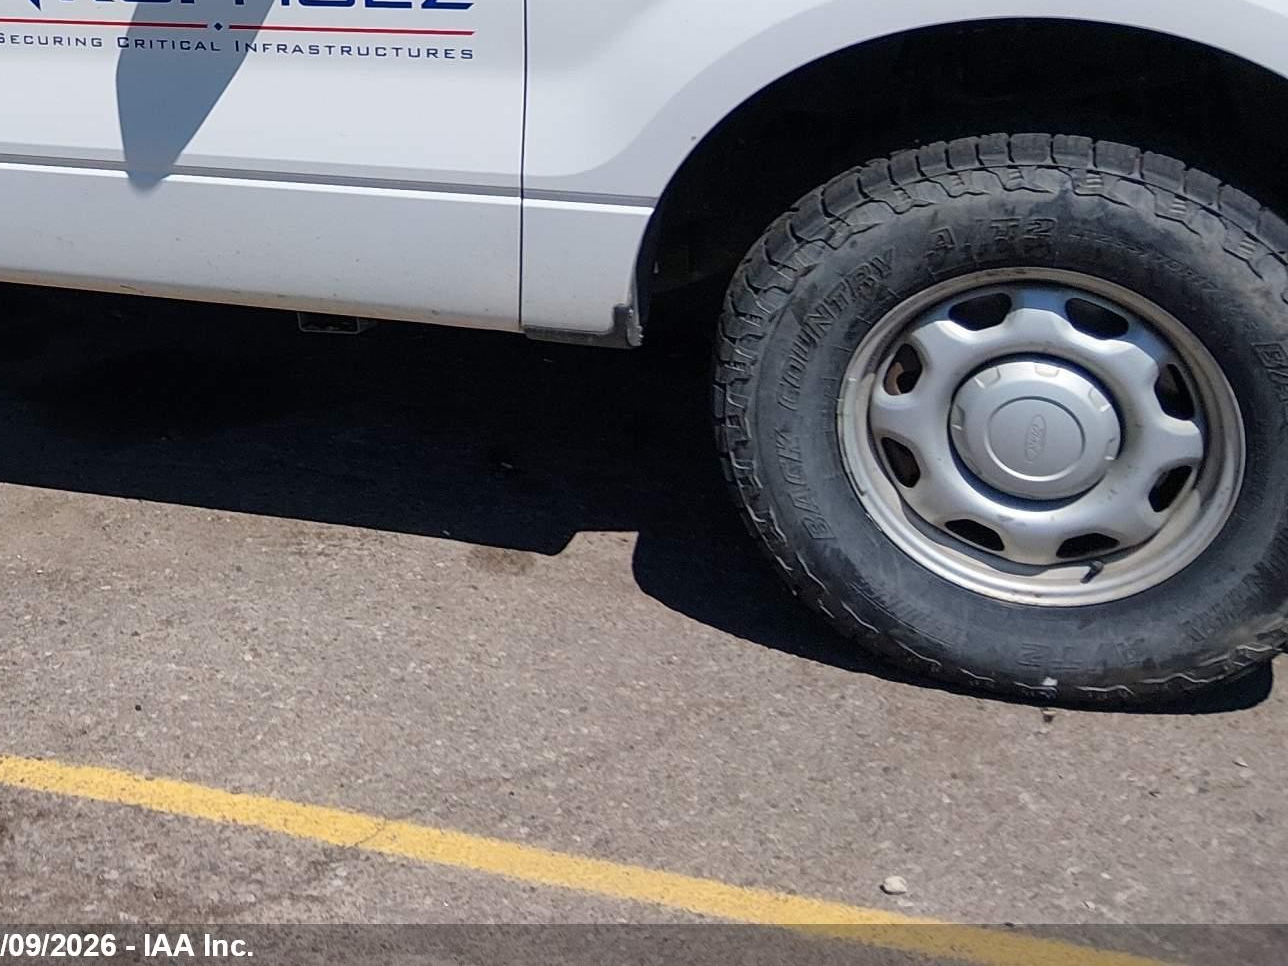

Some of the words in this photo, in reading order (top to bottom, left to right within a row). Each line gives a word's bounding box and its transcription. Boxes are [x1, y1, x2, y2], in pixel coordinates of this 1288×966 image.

[116, 36, 221, 53] CRITICAL
[234, 40, 475, 61] INFRASTRUCTURES
[778, 247, 896, 412] COUNTRY
[774, 425, 836, 539] BACK
